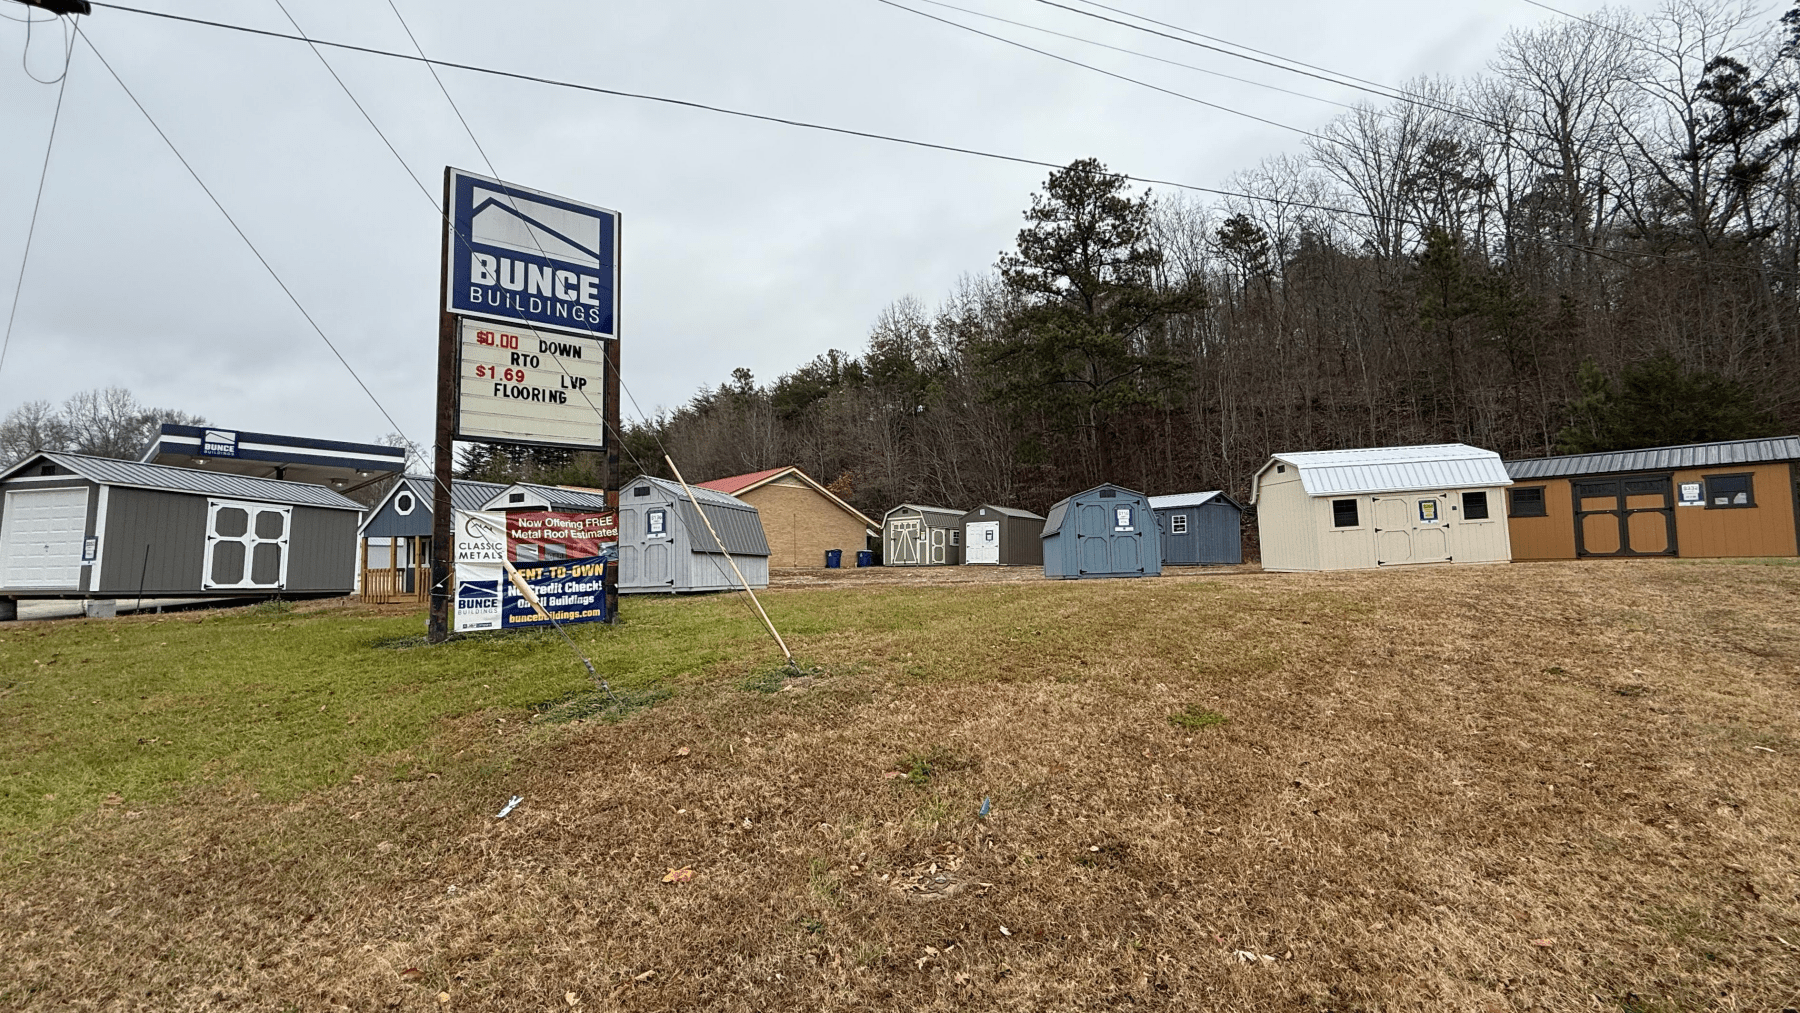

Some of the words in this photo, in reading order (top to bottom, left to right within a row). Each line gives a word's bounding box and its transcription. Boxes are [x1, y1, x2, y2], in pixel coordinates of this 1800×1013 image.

[470, 251, 600, 307] BUNCE
[470, 286, 600, 324] BUILDINGS
[476, 330, 519, 350] $0.00
[539, 339, 582, 359] DOWN
[510, 351, 540, 369] RTO
[475, 364, 525, 383] $1.69
[561, 374, 587, 390] LVP
[494, 382, 567, 404] FLOORING
[205, 443, 235, 453] BUNCE
[518, 517, 542, 528] Now
[545, 517, 583, 530] Offering
[585, 516, 613, 528] FREE
[511, 529, 541, 539] Metal
[543, 529, 569, 539] Roof
[570, 527, 618, 539] Estimates
[458, 542, 503, 551] CLASSIC
[458, 551, 503, 560] METALS
[564, 580, 603, 593] Check!
[458, 599, 498, 609] BUNCE
[517, 598, 531, 608] On
[549, 595, 595, 607] Buildings
